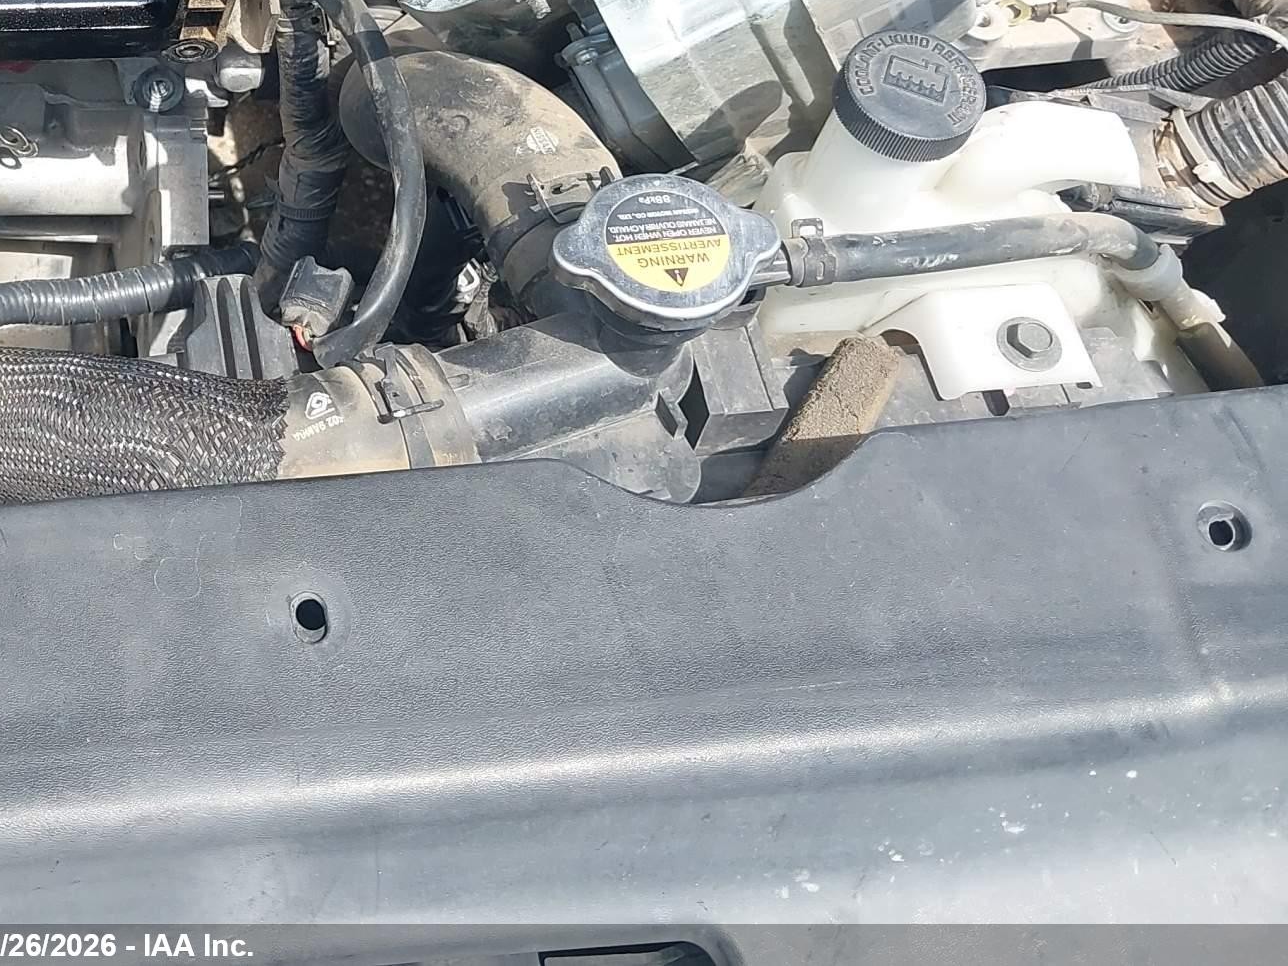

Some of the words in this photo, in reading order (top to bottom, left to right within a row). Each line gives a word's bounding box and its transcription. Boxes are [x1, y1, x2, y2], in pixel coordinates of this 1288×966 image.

[634, 231, 662, 241] WHEN
[663, 228, 687, 238] OPEN
[687, 227, 717, 236] NEVER
[617, 239, 721, 256] AVERTISSEMENT
[637, 253, 710, 268] WARNING
